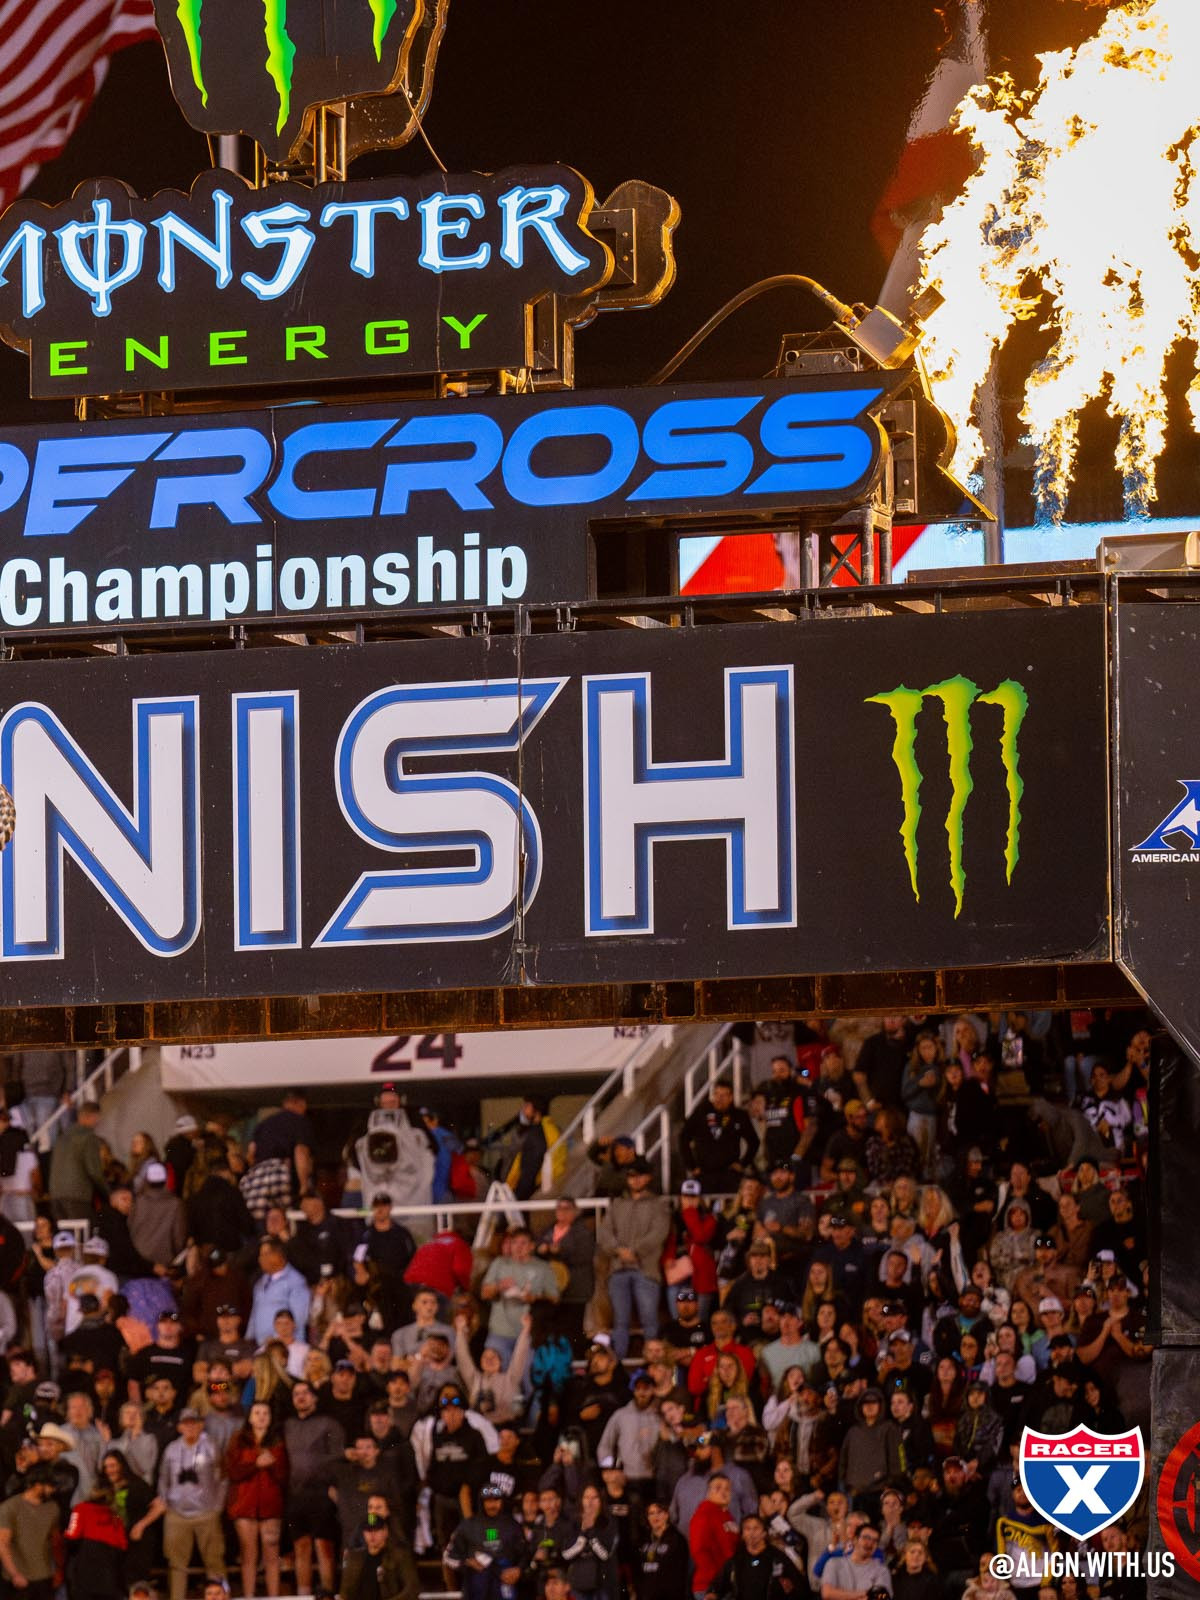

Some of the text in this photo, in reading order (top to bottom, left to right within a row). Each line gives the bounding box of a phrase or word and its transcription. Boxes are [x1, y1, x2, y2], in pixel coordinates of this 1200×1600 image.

[49, 313, 488, 377] ENERGY
[0, 532, 528, 627] Championship
[1131, 853, 1200, 863] AMERICAN
[371, 1032, 464, 1073] 24
